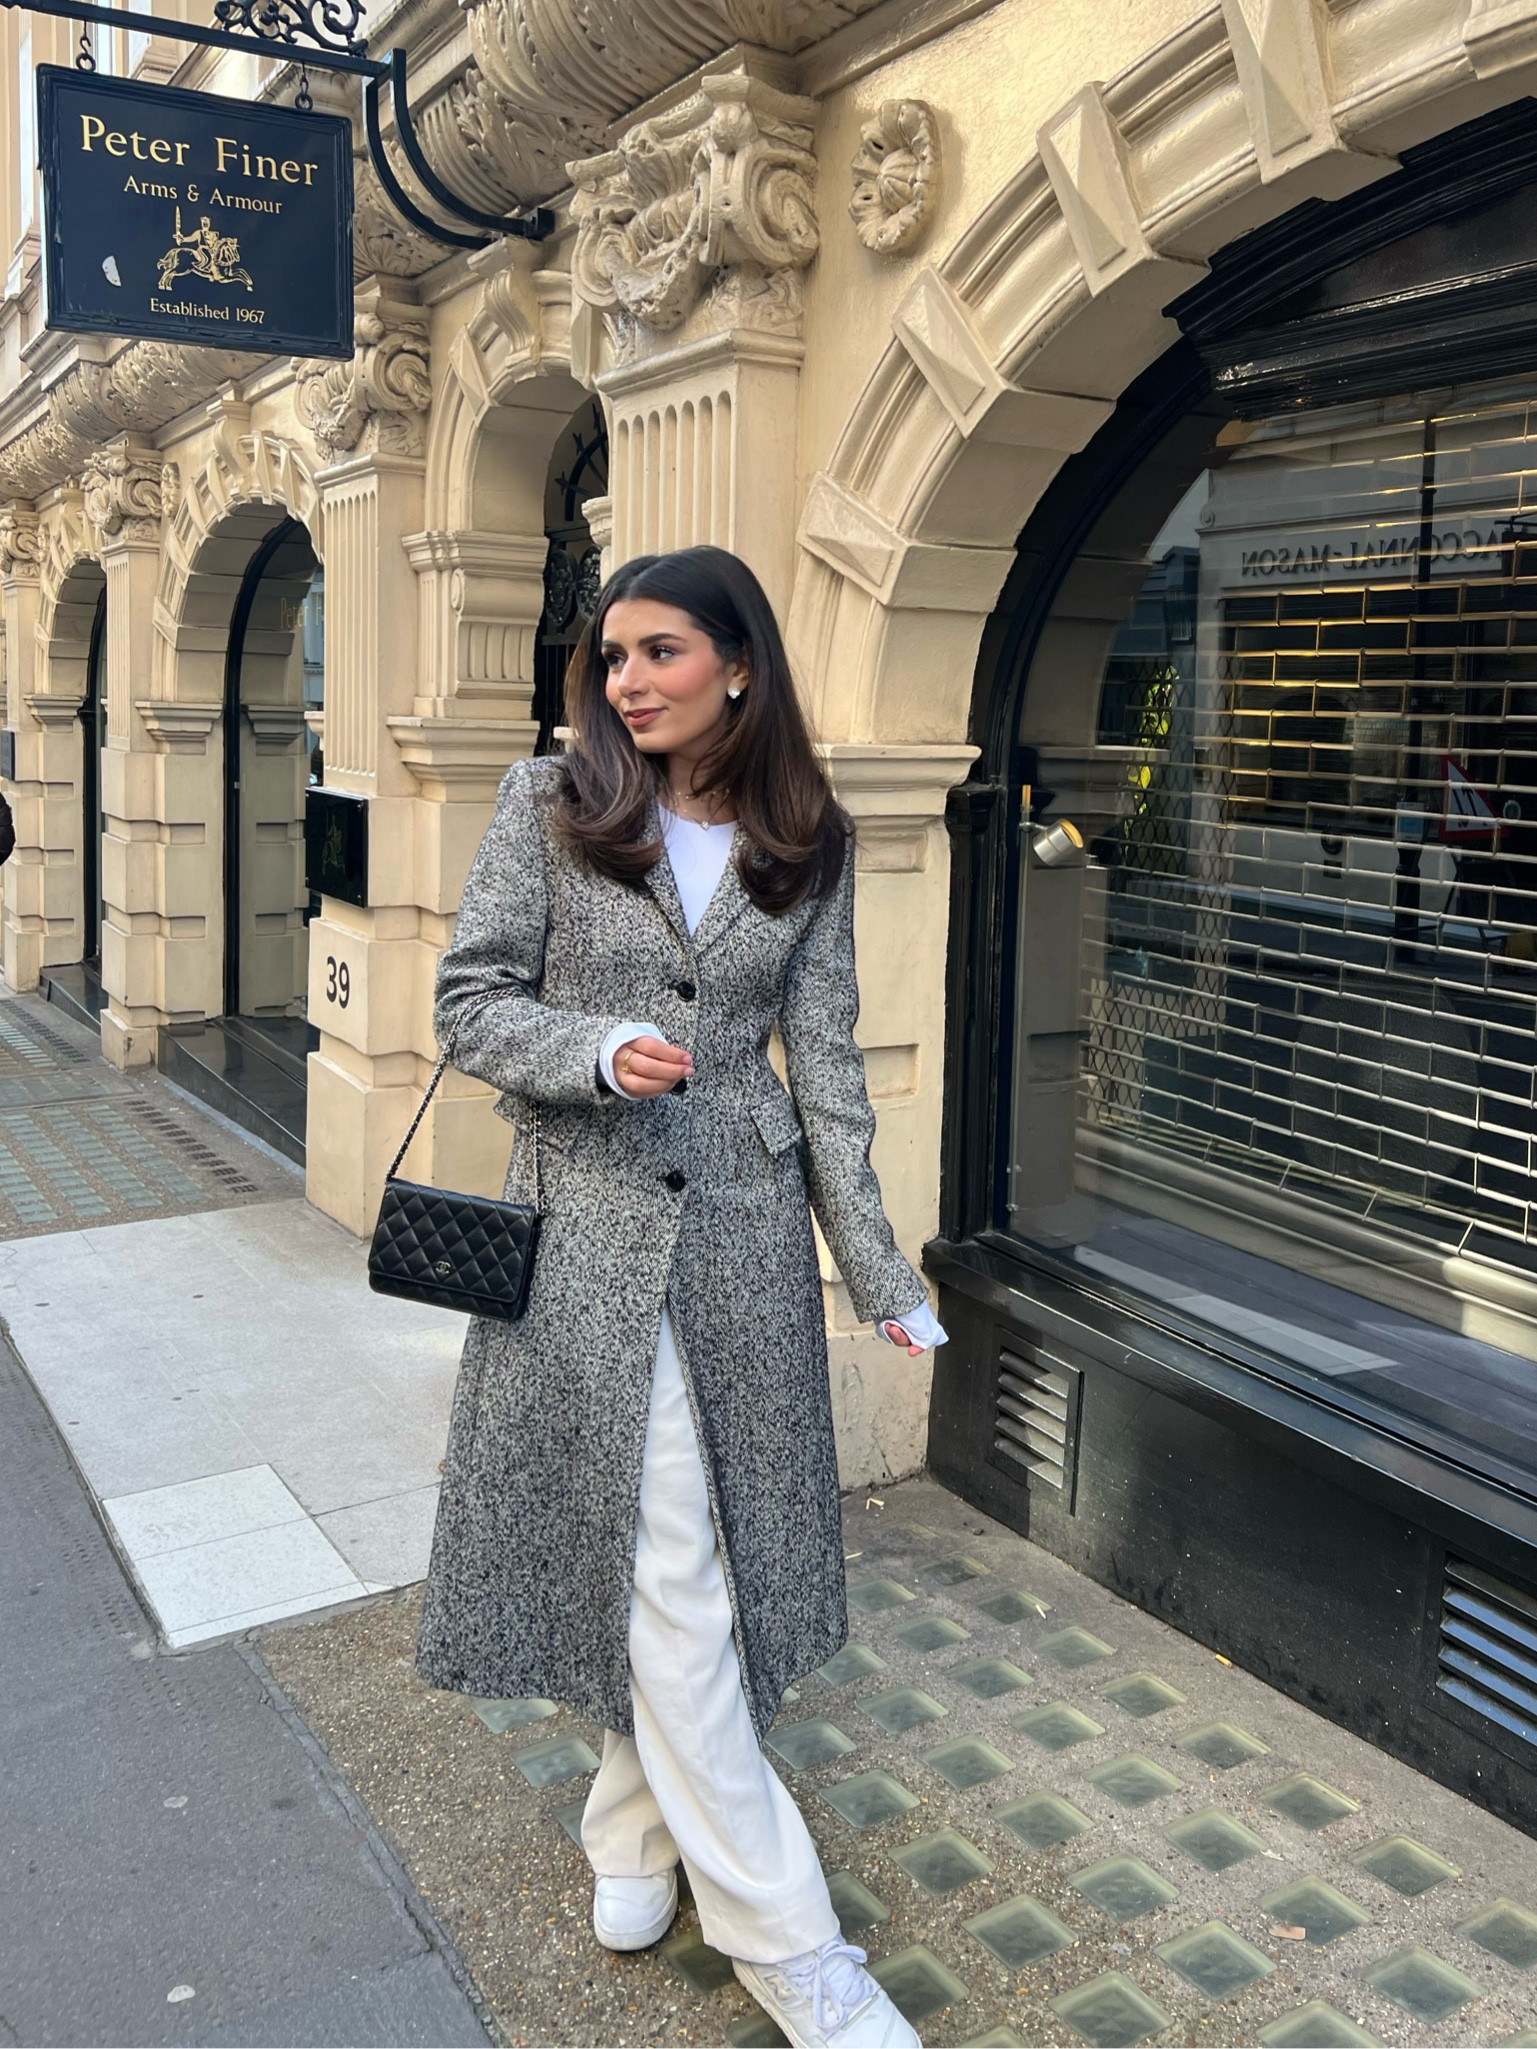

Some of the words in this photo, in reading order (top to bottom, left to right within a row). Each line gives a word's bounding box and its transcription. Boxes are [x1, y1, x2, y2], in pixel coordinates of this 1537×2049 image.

[80, 115, 191, 167] Peter
[215, 137, 319, 186] Finer
[124, 175, 178, 200] Arms
[186, 184, 200, 203] &
[210, 188, 283, 215] Armour
[150, 298, 230, 322] Established
[235, 308, 266, 325] 1967
[326, 956, 350, 1009] 39
